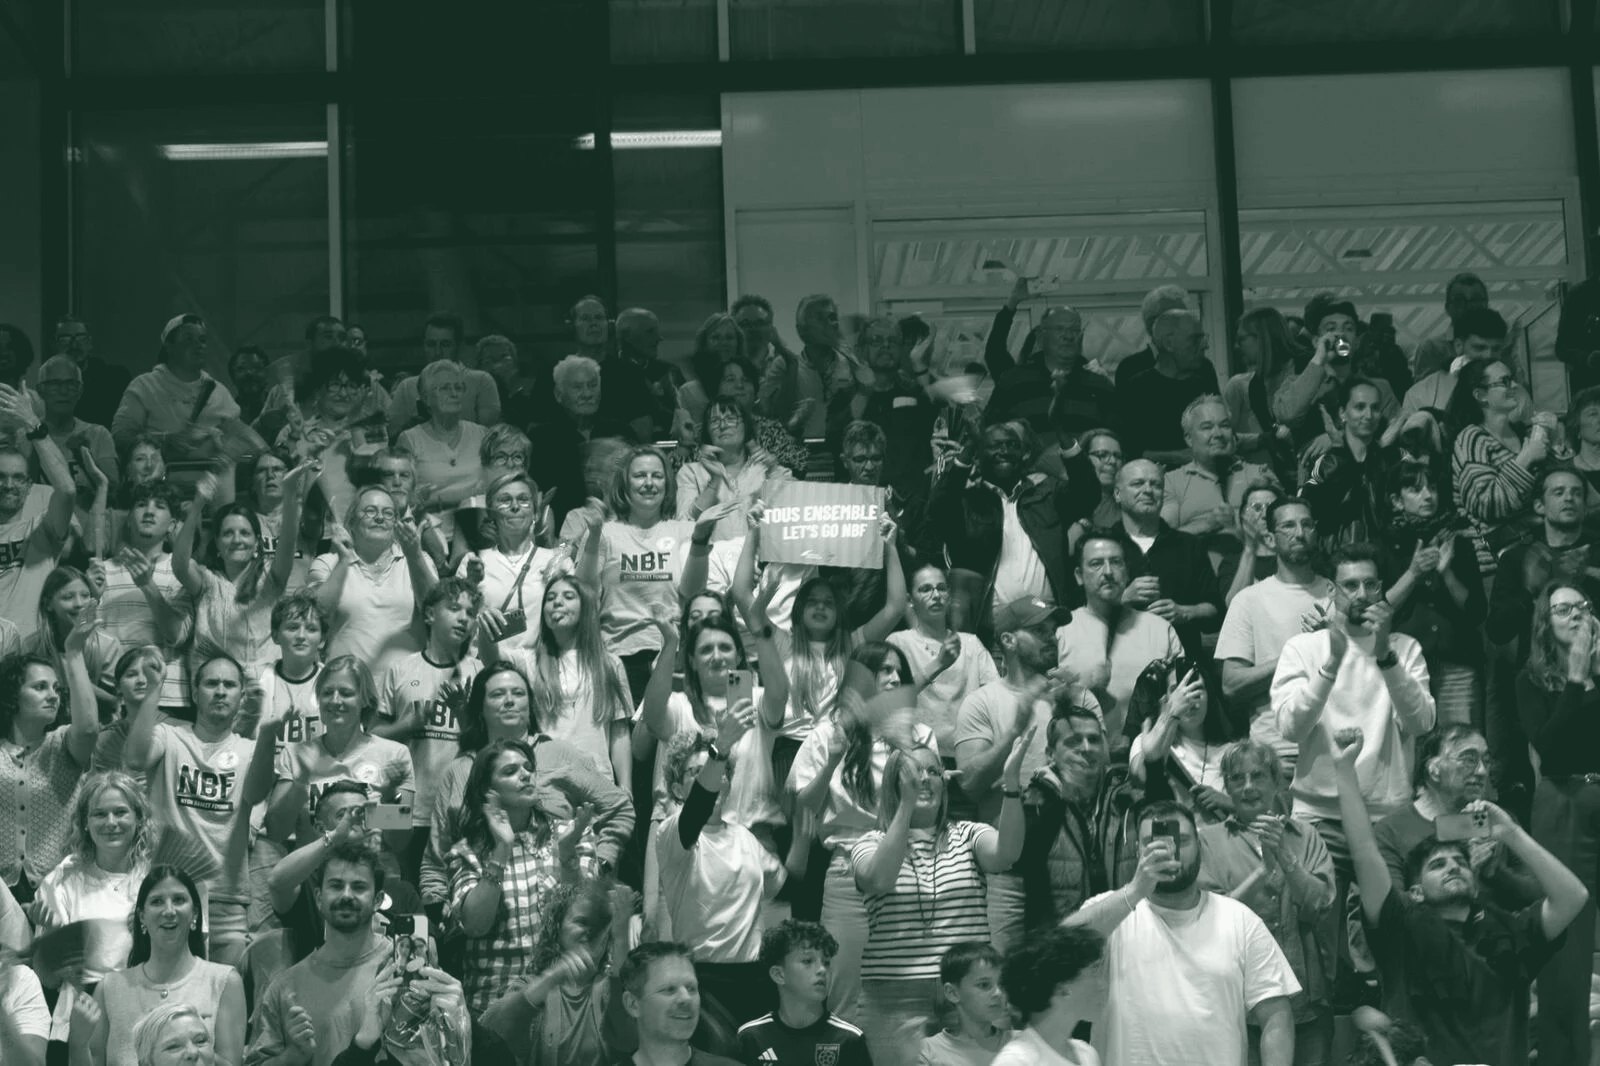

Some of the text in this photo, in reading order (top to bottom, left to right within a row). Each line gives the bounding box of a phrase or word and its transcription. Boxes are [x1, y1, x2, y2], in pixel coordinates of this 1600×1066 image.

[763, 504, 878, 524] TOUS ENSEMBLE
[783, 523, 868, 540] LET'S GO NBF
[621, 551, 670, 571] NBF
[178, 765, 235, 799] NBF
